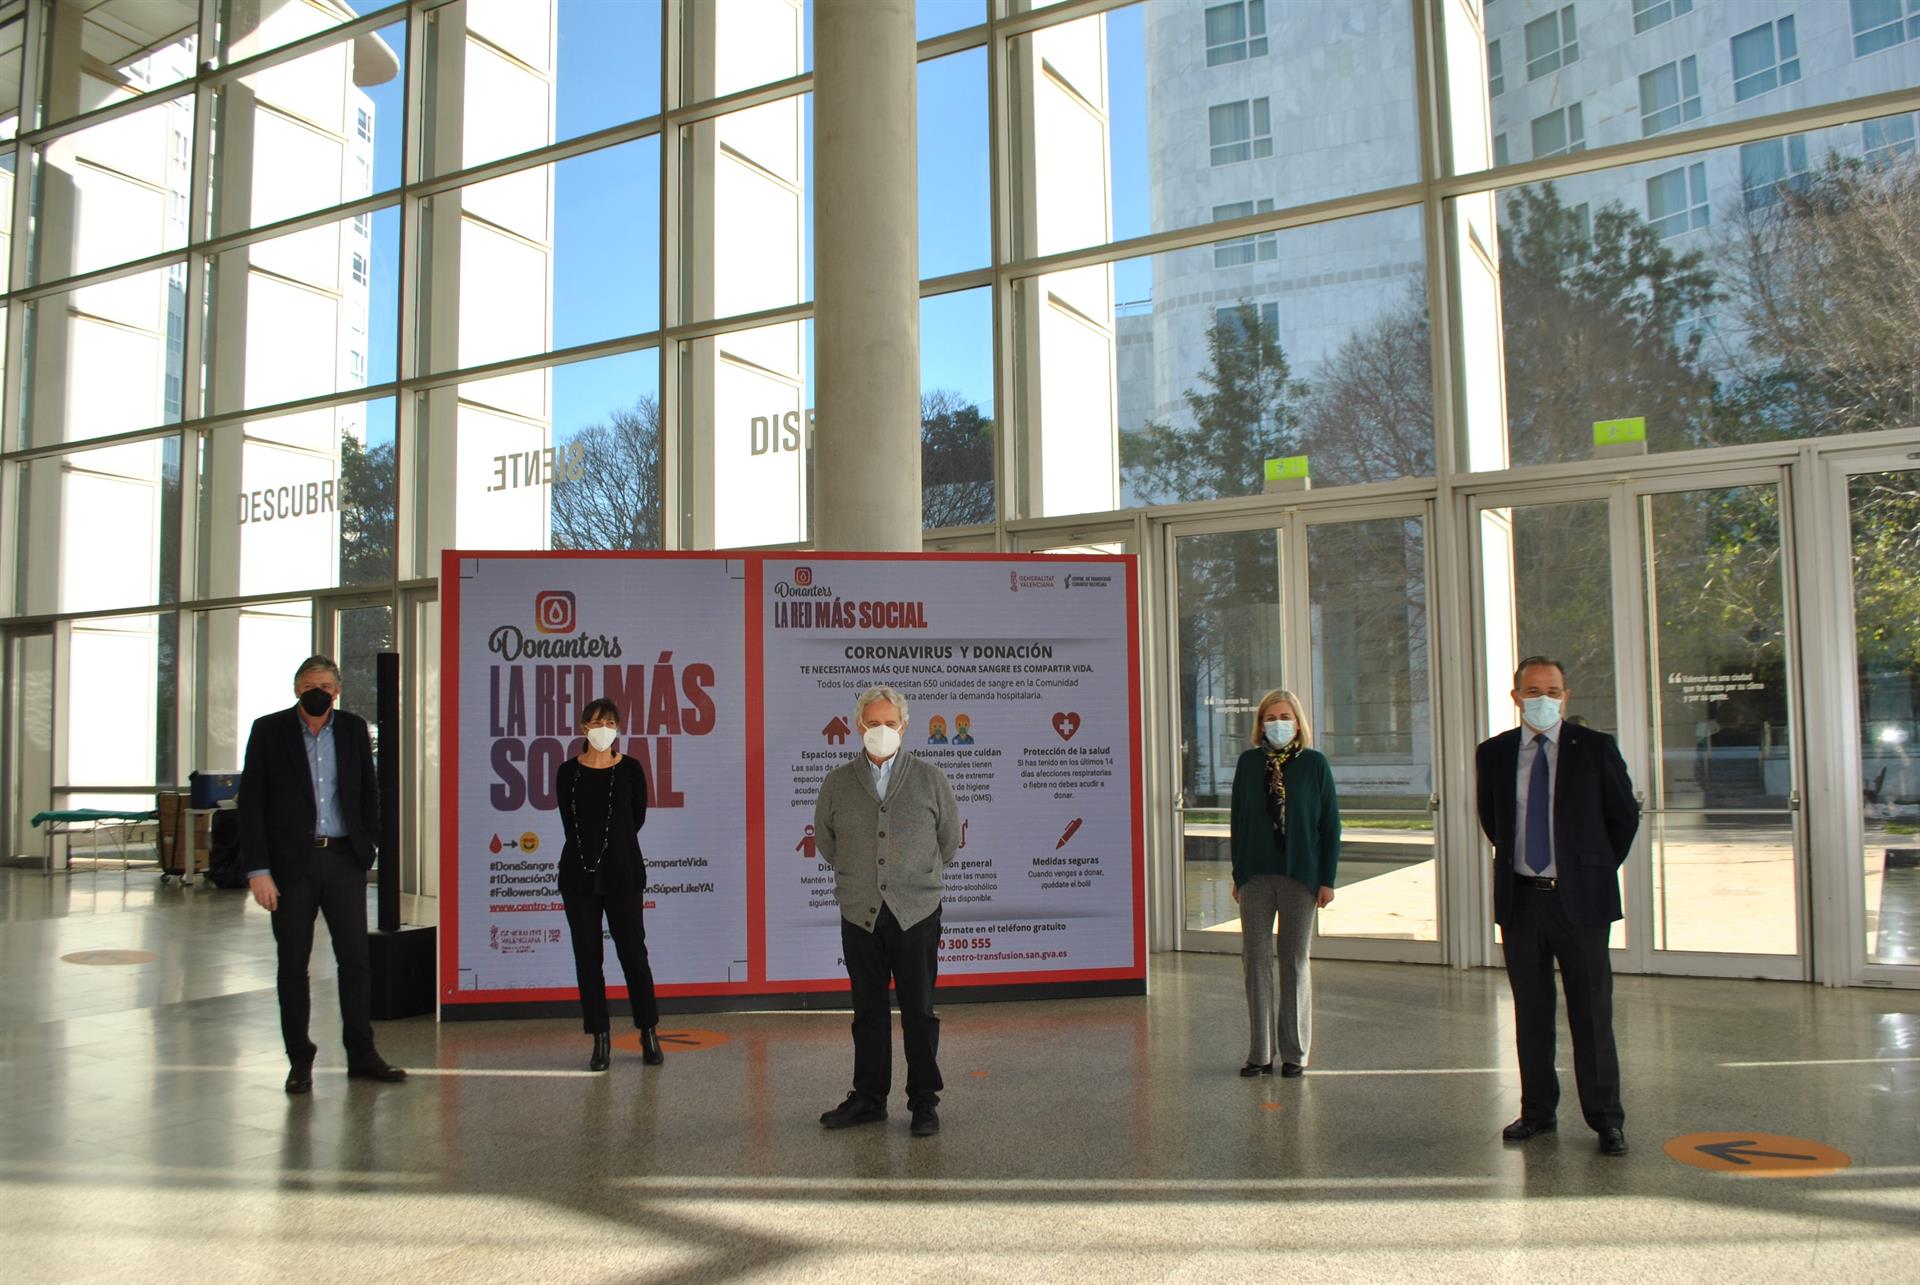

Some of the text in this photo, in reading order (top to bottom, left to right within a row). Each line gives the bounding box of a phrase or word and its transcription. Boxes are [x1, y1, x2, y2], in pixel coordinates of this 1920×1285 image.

[774, 582, 832, 598] Donanters
[775, 597, 928, 629] LA RED MÁS SOCIAL
[488, 625, 622, 661] Donanters
[844, 643, 1053, 659] CORONAVIRUS Y DONACIÓN
[800, 664, 1094, 675] TE NECESITAMOS MÁS QUE NUNCA. DONAR SANGRE ES COMPARTIR VIDA.
[817, 680, 841, 688] Todos
[843, 679, 854, 688] los
[856, 679, 872, 688] días
[885, 680, 921, 688] necesitan
[923, 680, 938, 688] 650
[940, 679, 974, 688] unidades
[977, 679, 986, 687] de
[988, 680, 1013, 689] sangre
[1026, 679, 1034, 687] la
[1035, 678, 1078, 687] Comunidad
[490, 665, 526, 737] LA
[603, 651, 716, 736] MÁS
[950, 692, 957, 700] la
[958, 691, 995, 700] demanda
[997, 691, 1043, 701] hospitalaria.
[801, 750, 837, 760] Espacios
[974, 748, 1002, 757] cuidan
[1024, 746, 1110, 757] Protección de la salud
[490, 736, 684, 811] SOAL
[1072, 769, 1112, 778] respiratorias
[793, 776, 824, 784] espacios
[966, 783, 990, 792] higiene
[490, 861, 554, 873] #DonaSangre
[962, 859, 992, 870] general
[1033, 857, 1099, 867] Medidas seguras
[490, 873, 558, 884] #1Donación3V
[801, 876, 826, 884] Mantén
[1054, 871, 1077, 880] vengas
[490, 887, 562, 898] #FollowersQue
[988, 924, 995, 933] el
[998, 924, 1032, 933] teléfono
[1033, 922, 1067, 934] gratuito
[948, 939, 968, 950] 300
[971, 938, 992, 949] 555
